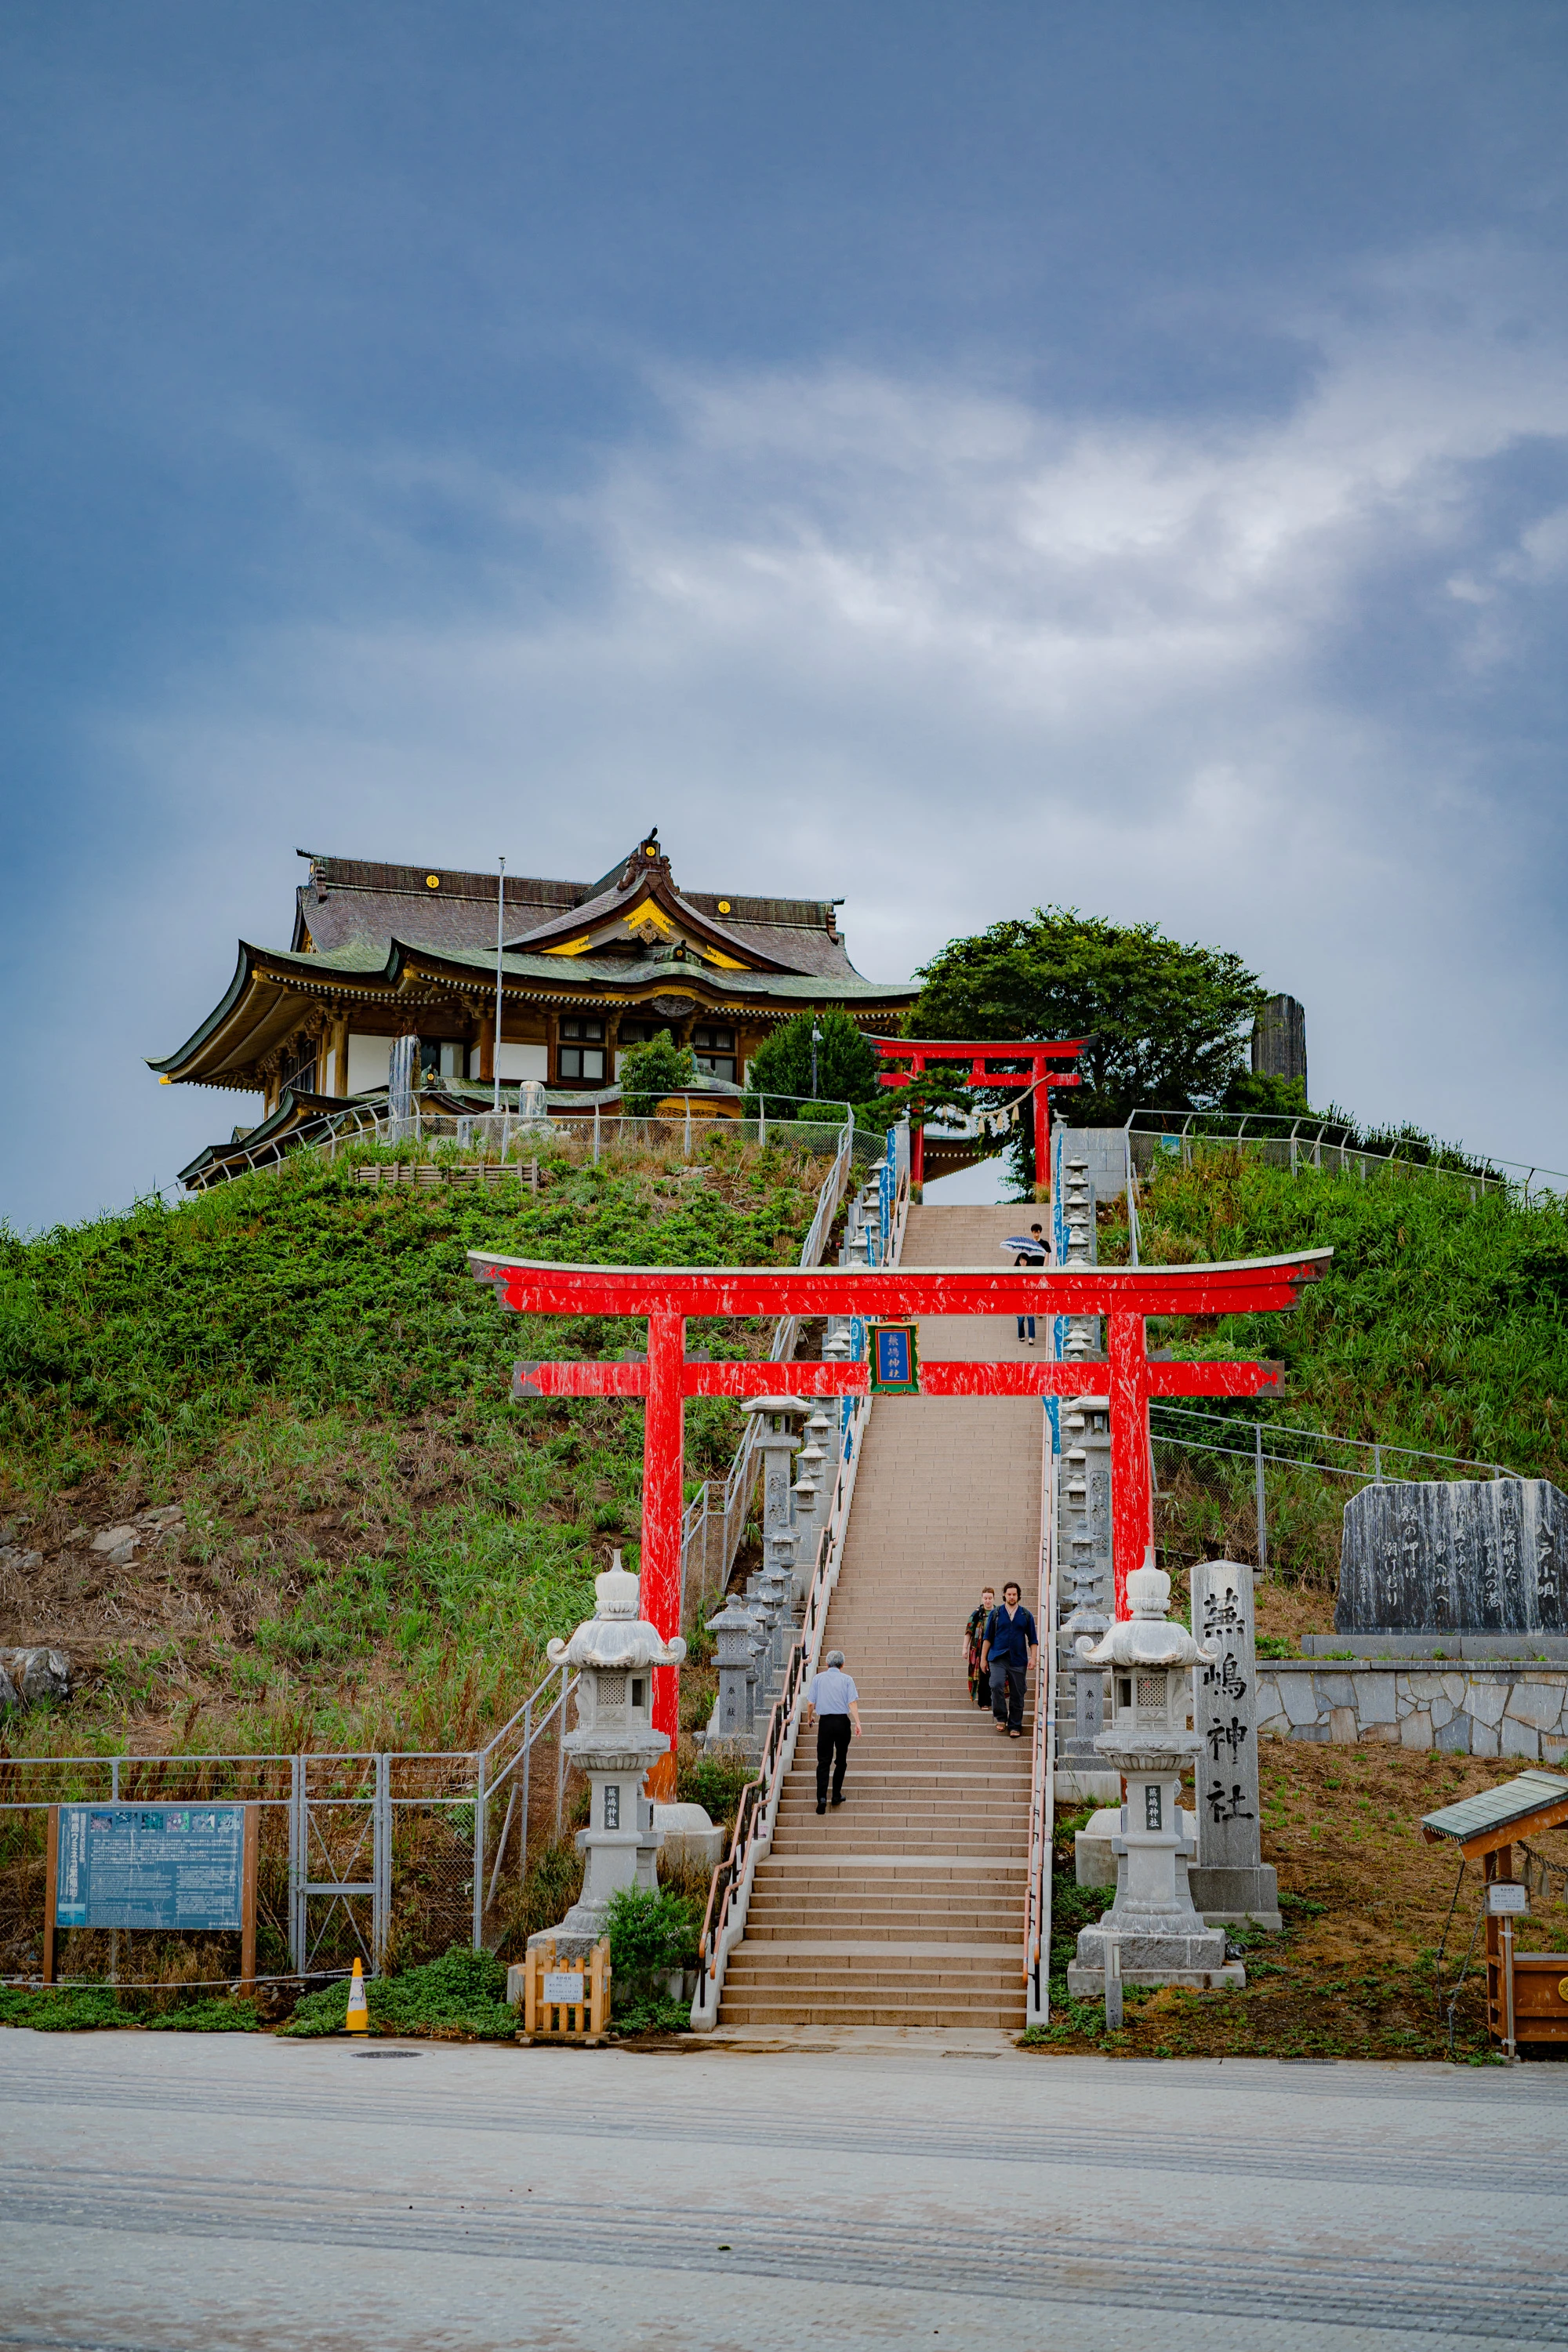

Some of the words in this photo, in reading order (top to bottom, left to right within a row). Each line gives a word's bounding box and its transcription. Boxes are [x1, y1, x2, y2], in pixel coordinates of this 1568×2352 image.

[769, 1477, 787, 1523] 御神
[1535, 1519, 1556, 1599] 八戸小唄
[1203, 1587, 1254, 1824] 蕪嶋神社
